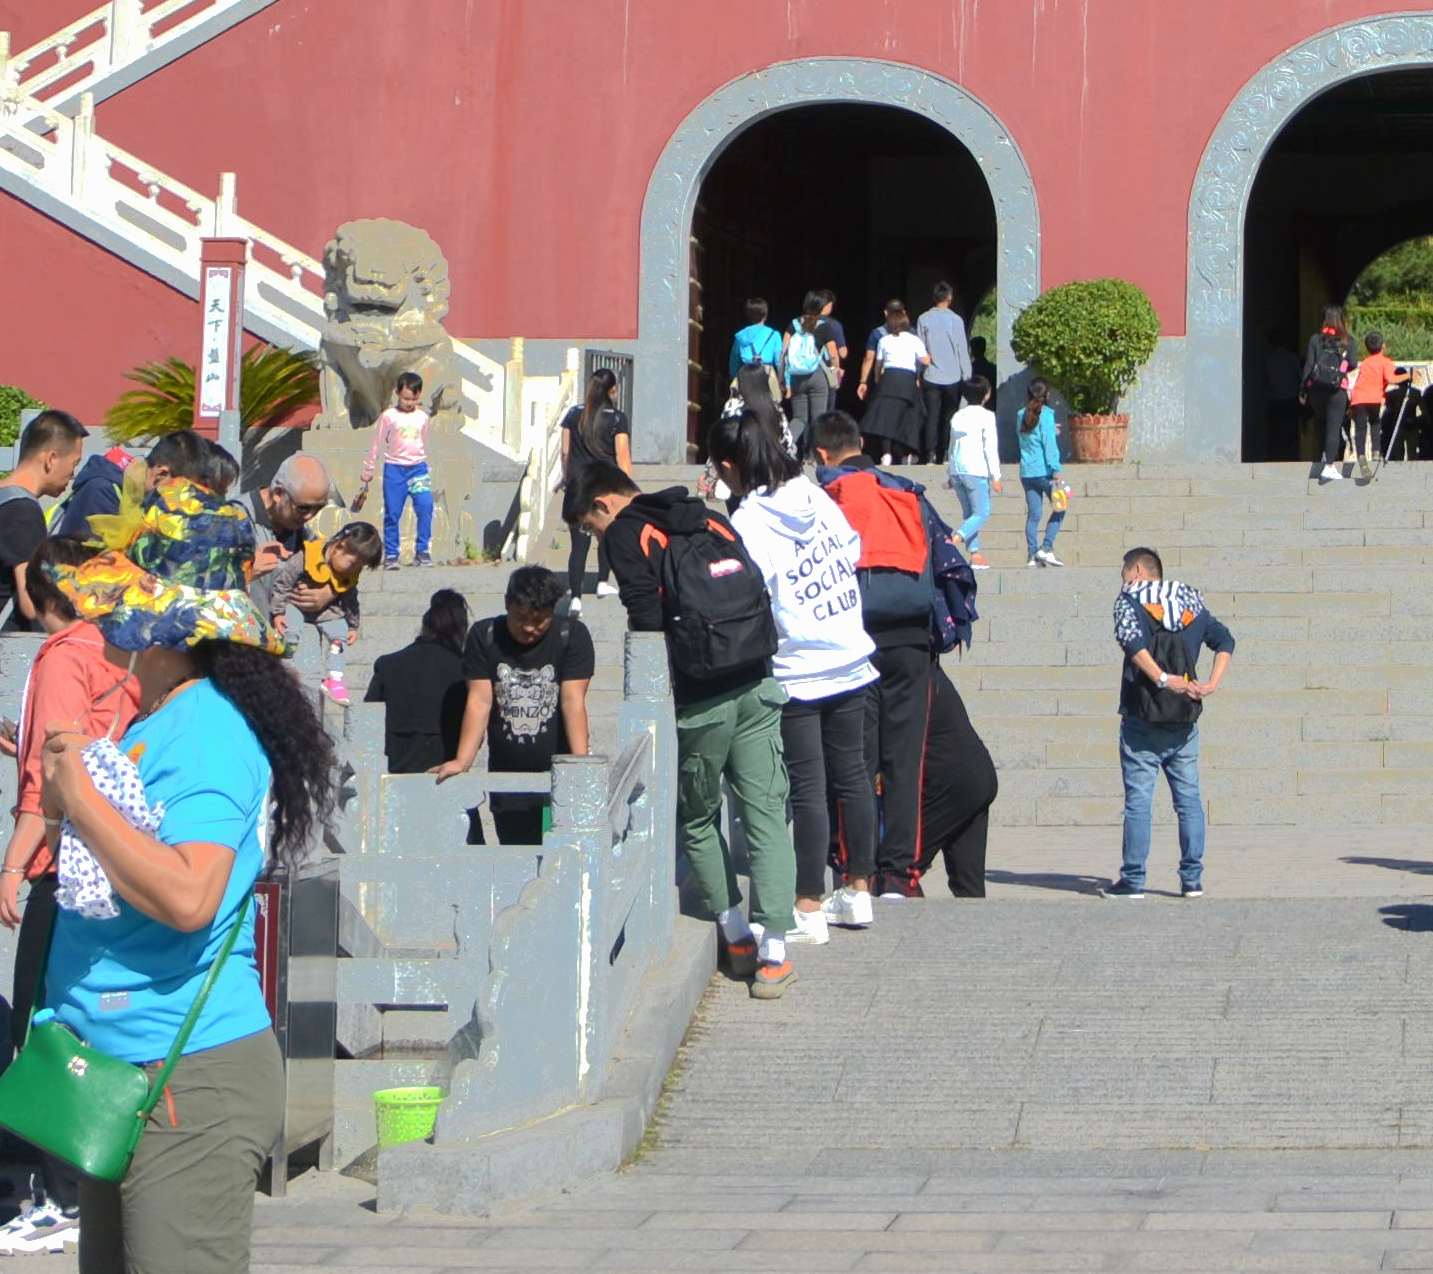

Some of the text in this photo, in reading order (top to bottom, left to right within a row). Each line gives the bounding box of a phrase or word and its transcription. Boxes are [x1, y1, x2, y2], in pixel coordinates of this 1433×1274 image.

[786, 534, 844, 585] SOCIAL
[794, 557, 857, 605] SOCIAL
[813, 589, 857, 621] CLUB
